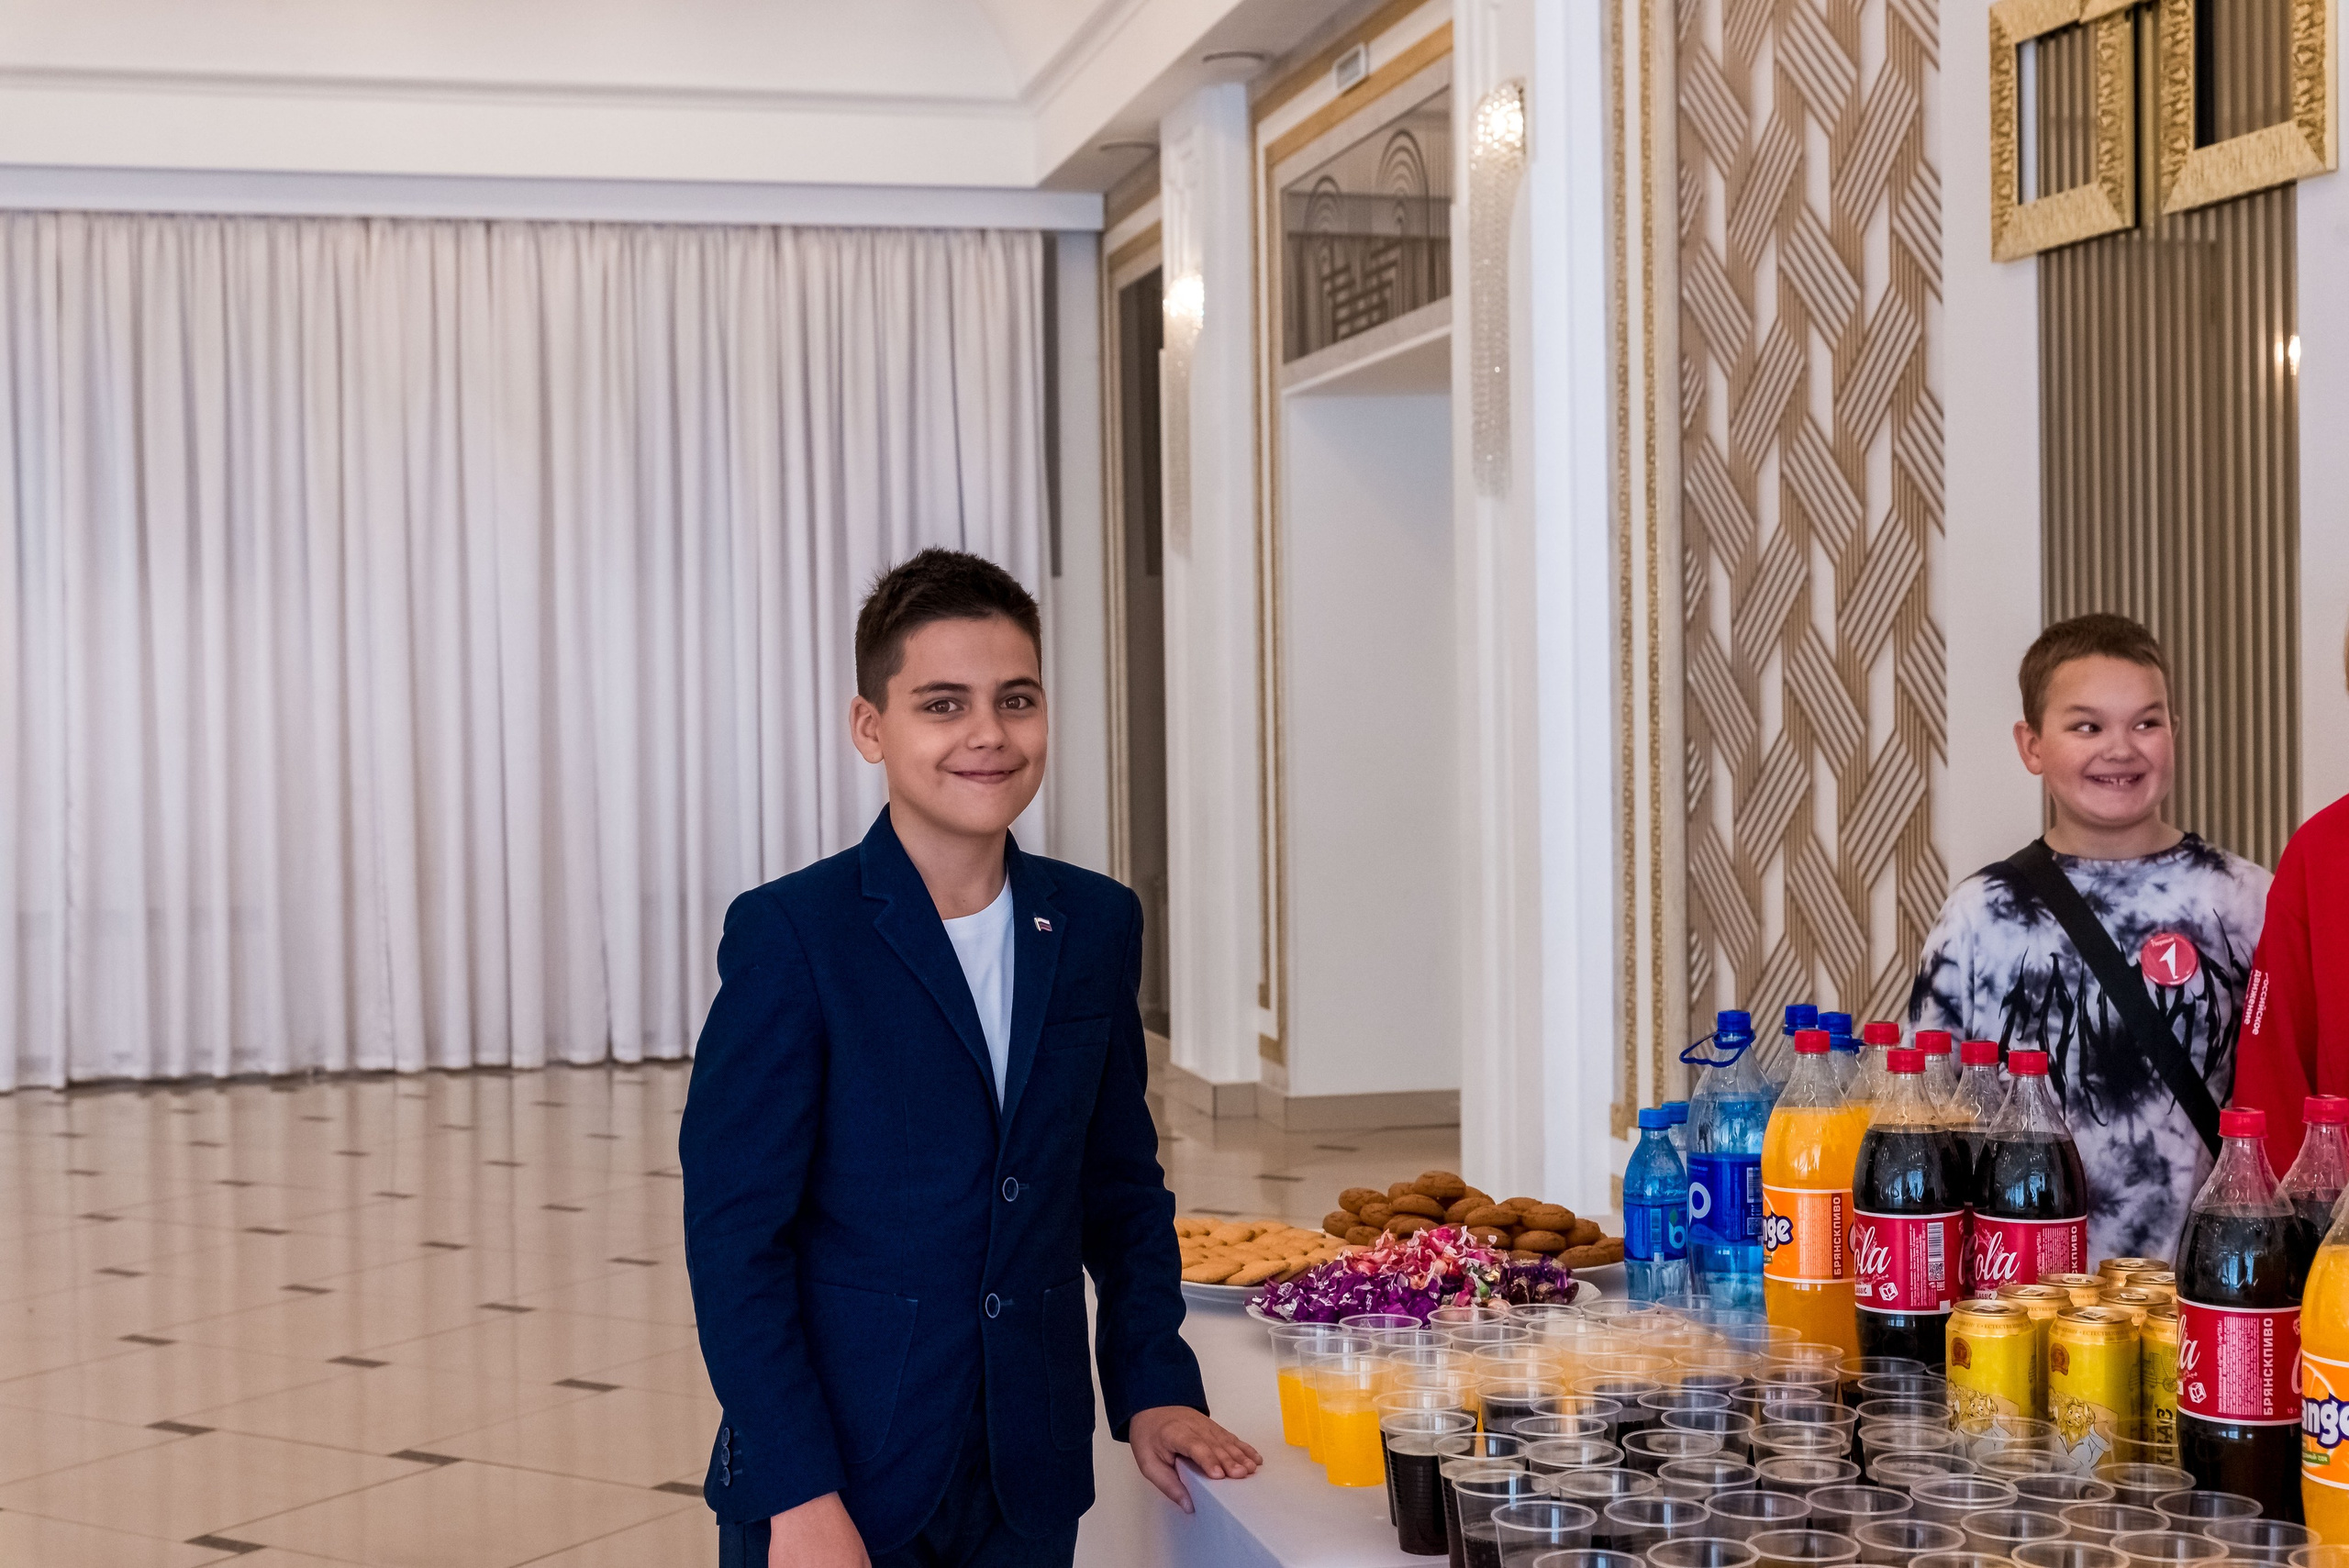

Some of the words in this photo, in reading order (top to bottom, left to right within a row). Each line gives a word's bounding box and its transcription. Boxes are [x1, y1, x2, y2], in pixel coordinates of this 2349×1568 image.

[1763, 1216, 1790, 1249] nge
[1833, 1196, 1842, 1275] БРЯНСКПИВО
[1854, 1226, 1892, 1274] ola
[1975, 1230, 2021, 1281] ola
[2177, 1314, 2200, 1371] la
[2263, 1318, 2274, 1416] БРЯНСКПИВО
[2301, 1399, 2349, 1445] ange
